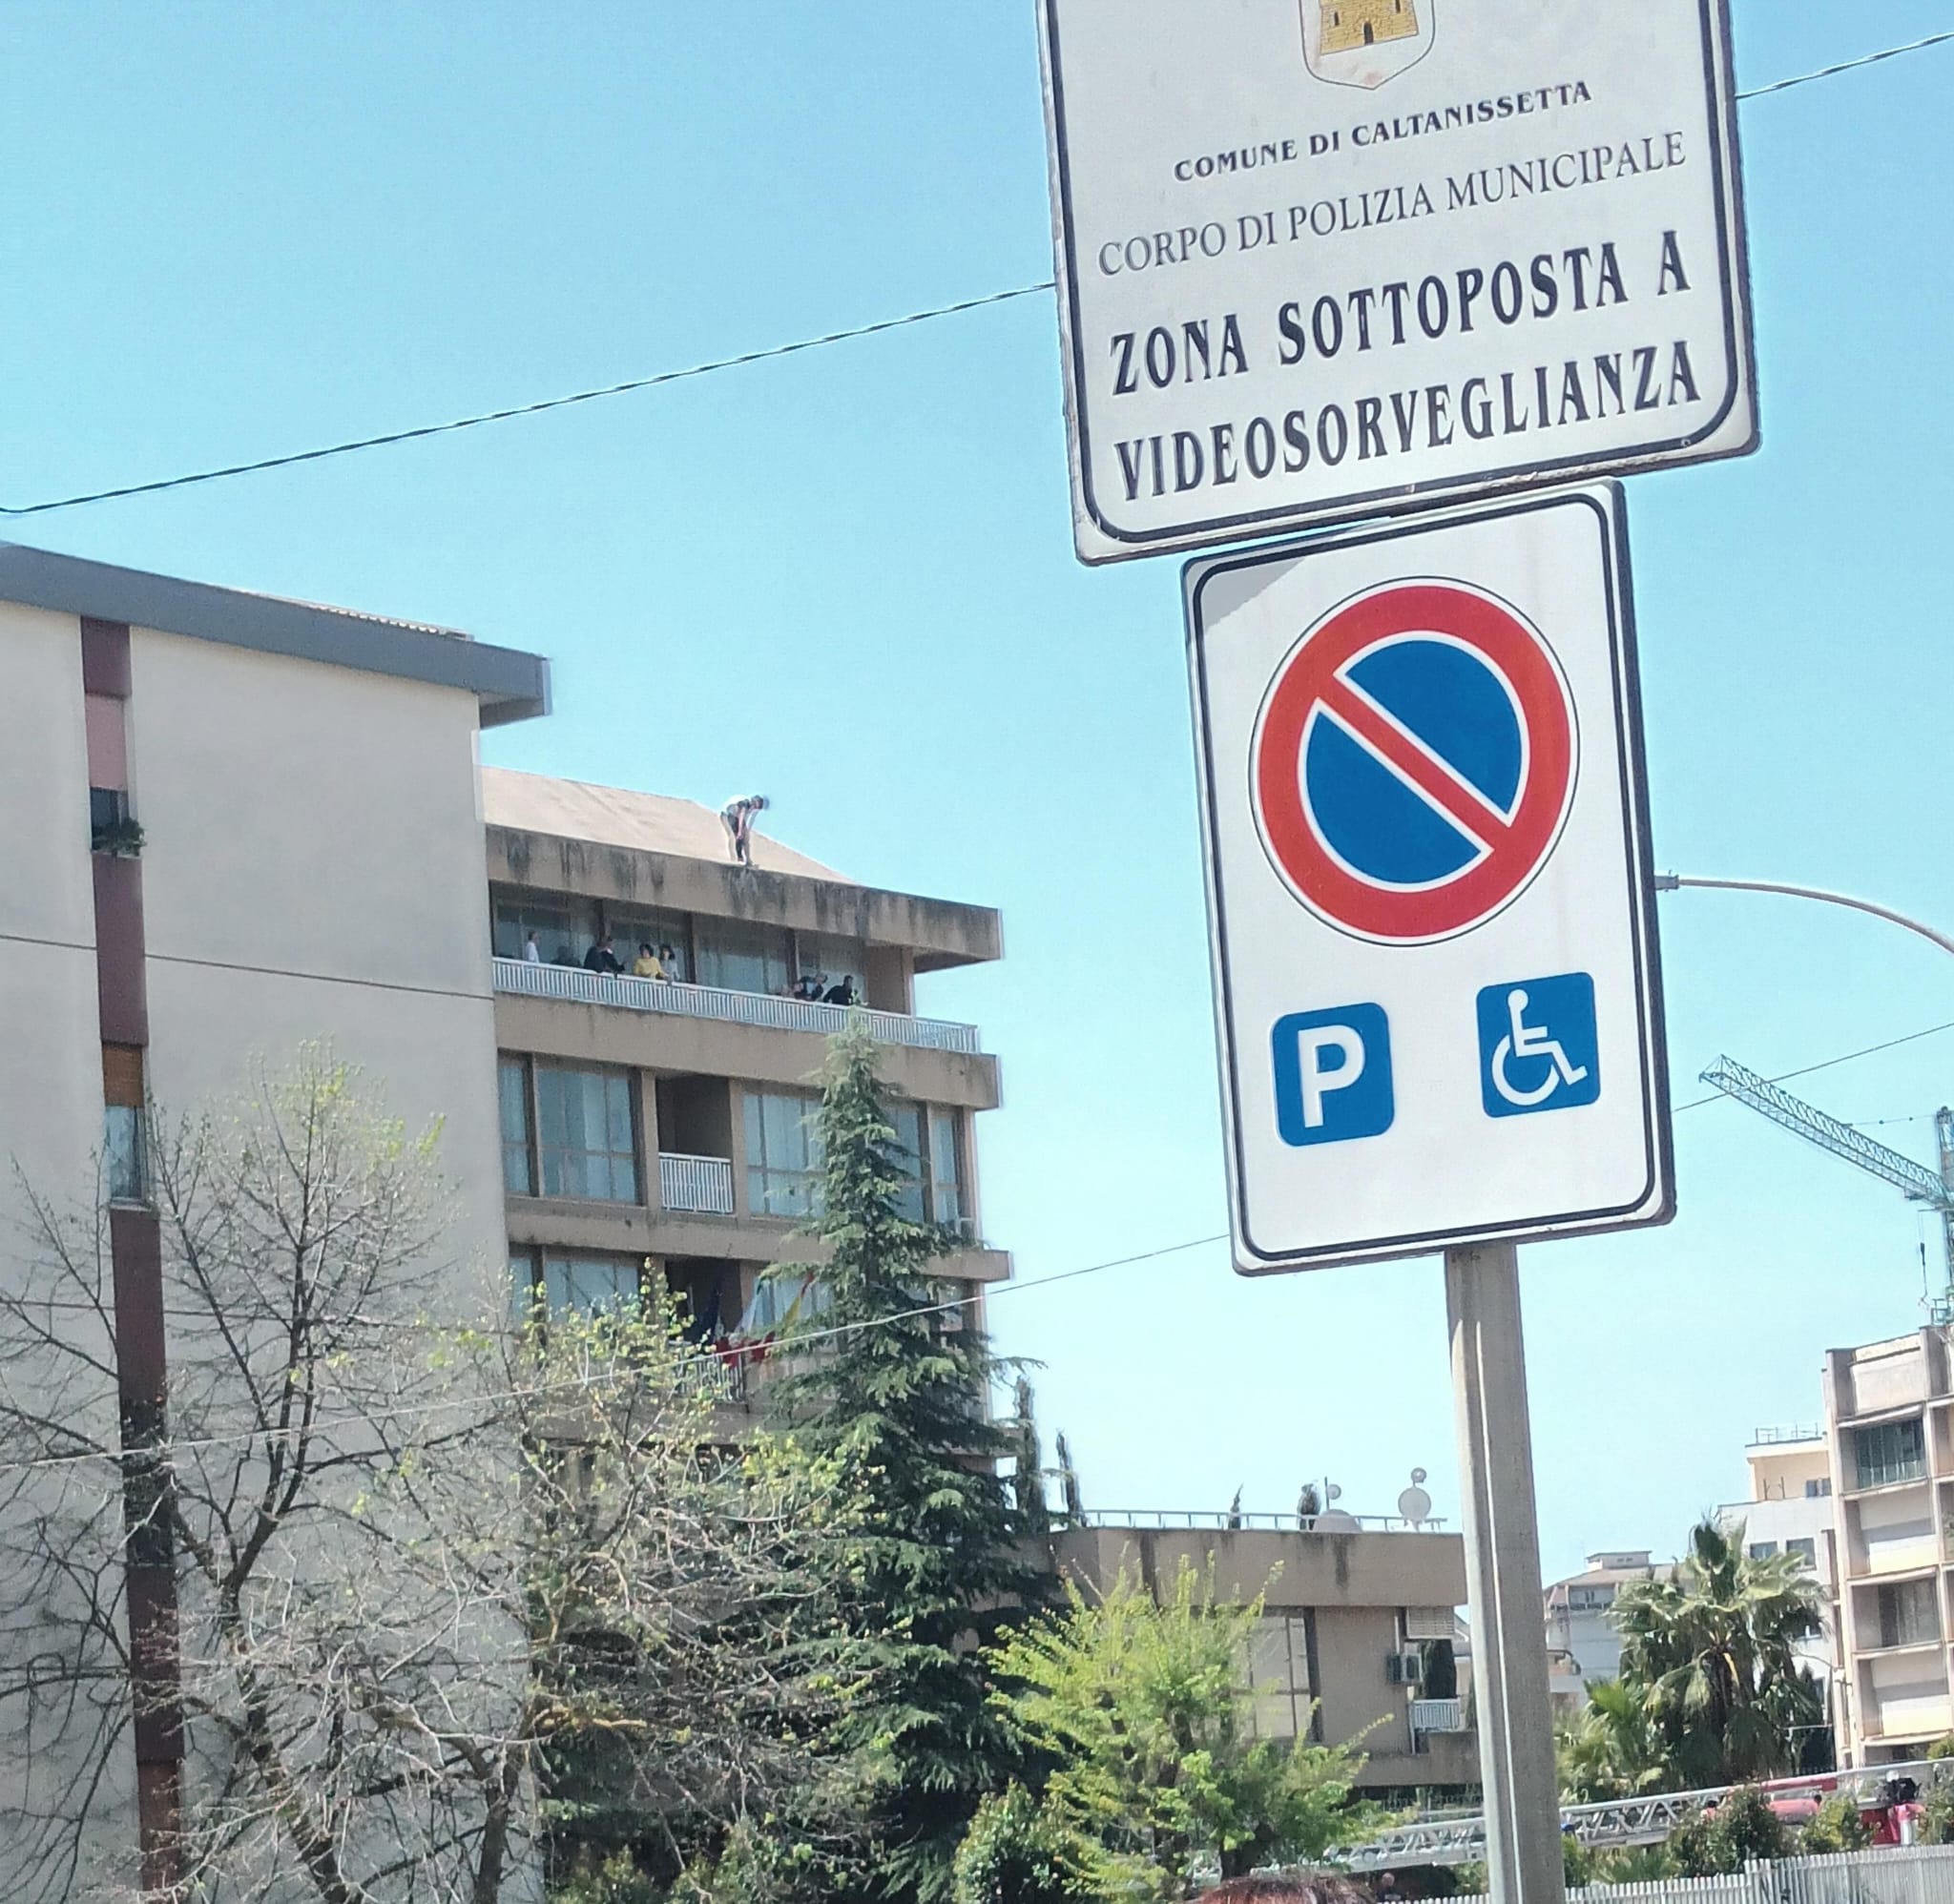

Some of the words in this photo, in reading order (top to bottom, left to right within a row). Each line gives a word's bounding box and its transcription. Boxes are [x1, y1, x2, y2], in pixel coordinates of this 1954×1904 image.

[1098, 222, 1226, 276] CORPO
[1237, 211, 1278, 251] DI
[1288, 182, 1435, 241] POLIZIA
[1445, 131, 1686, 211] MUNICIPALE
[1174, 140, 1298, 181] COMUNE
[1309, 131, 1340, 155] DI
[1351, 81, 1591, 147] CALTANISSETTA
[1110, 313, 1249, 396] ZONA
[1278, 241, 1629, 365] SOTTOPOSTA
[1657, 230, 1692, 296] A
[1113, 340, 1701, 502] VIDEOSORVEGLIANZA
[1298, 1024, 1366, 1128] P
